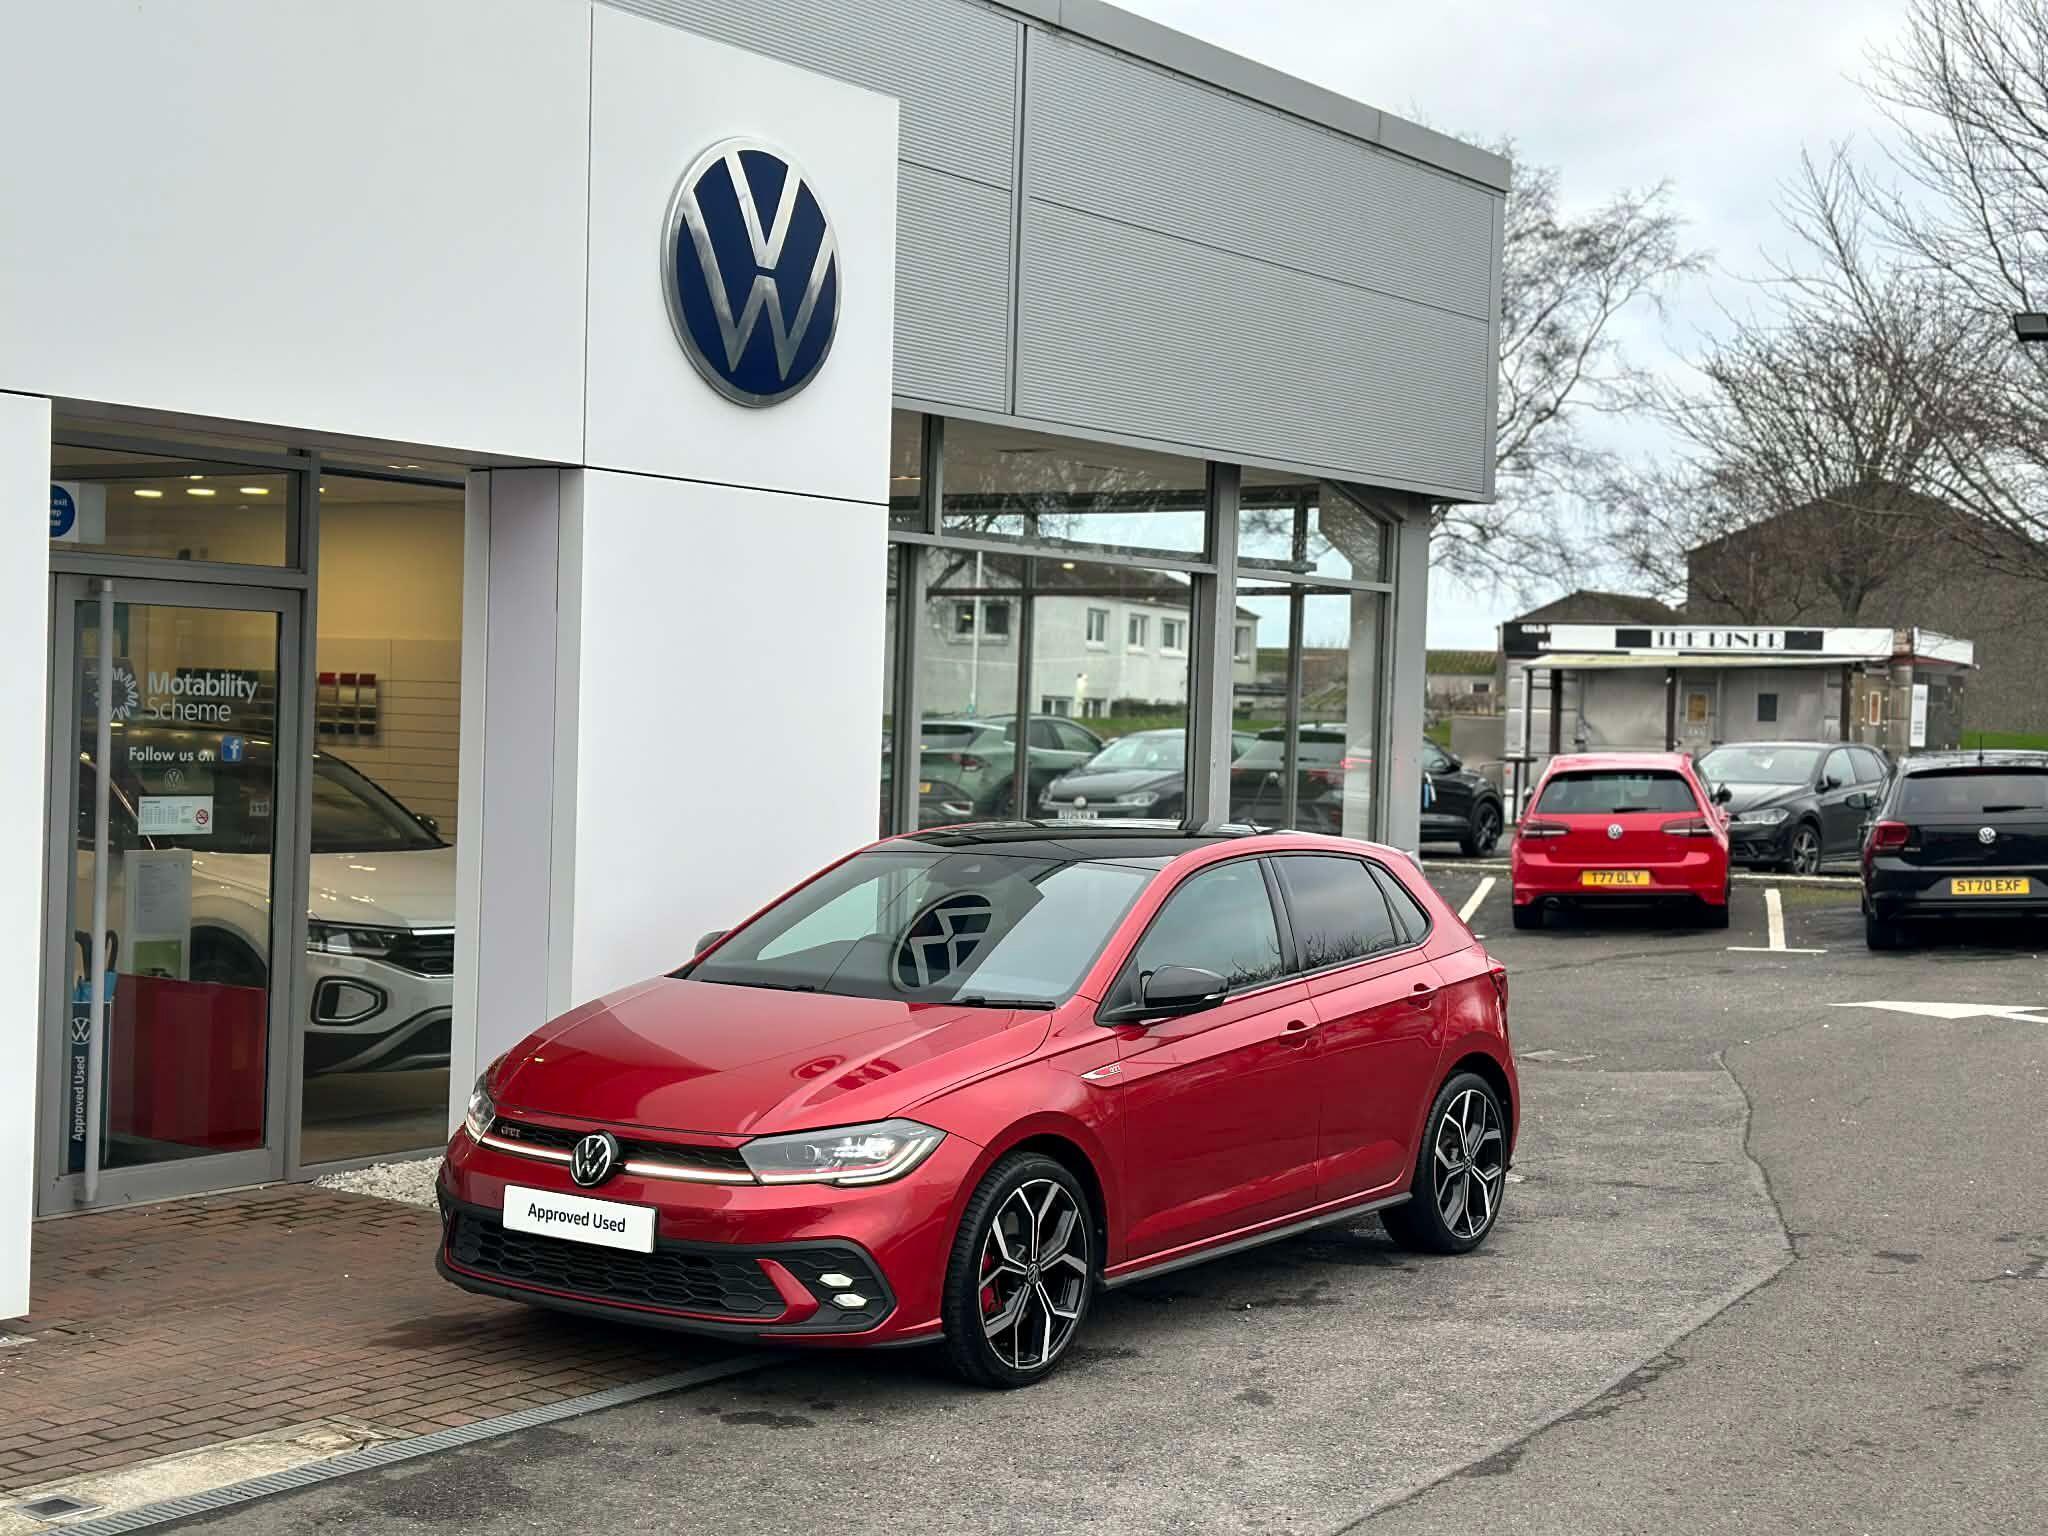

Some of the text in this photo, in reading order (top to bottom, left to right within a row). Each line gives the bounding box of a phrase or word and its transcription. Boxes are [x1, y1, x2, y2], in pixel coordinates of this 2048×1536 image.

[147, 671, 258, 704] Motability
[146, 696, 232, 722] Scheme
[129, 746, 175, 761] Follow
[179, 751, 194, 761] us
[198, 750, 215, 761] on
[1592, 871, 1614, 884] T77
[1956, 880, 2022, 892] ST70 EXF
[72, 1055, 87, 1141] Approved Used
[527, 1202, 626, 1233] Approved Used
